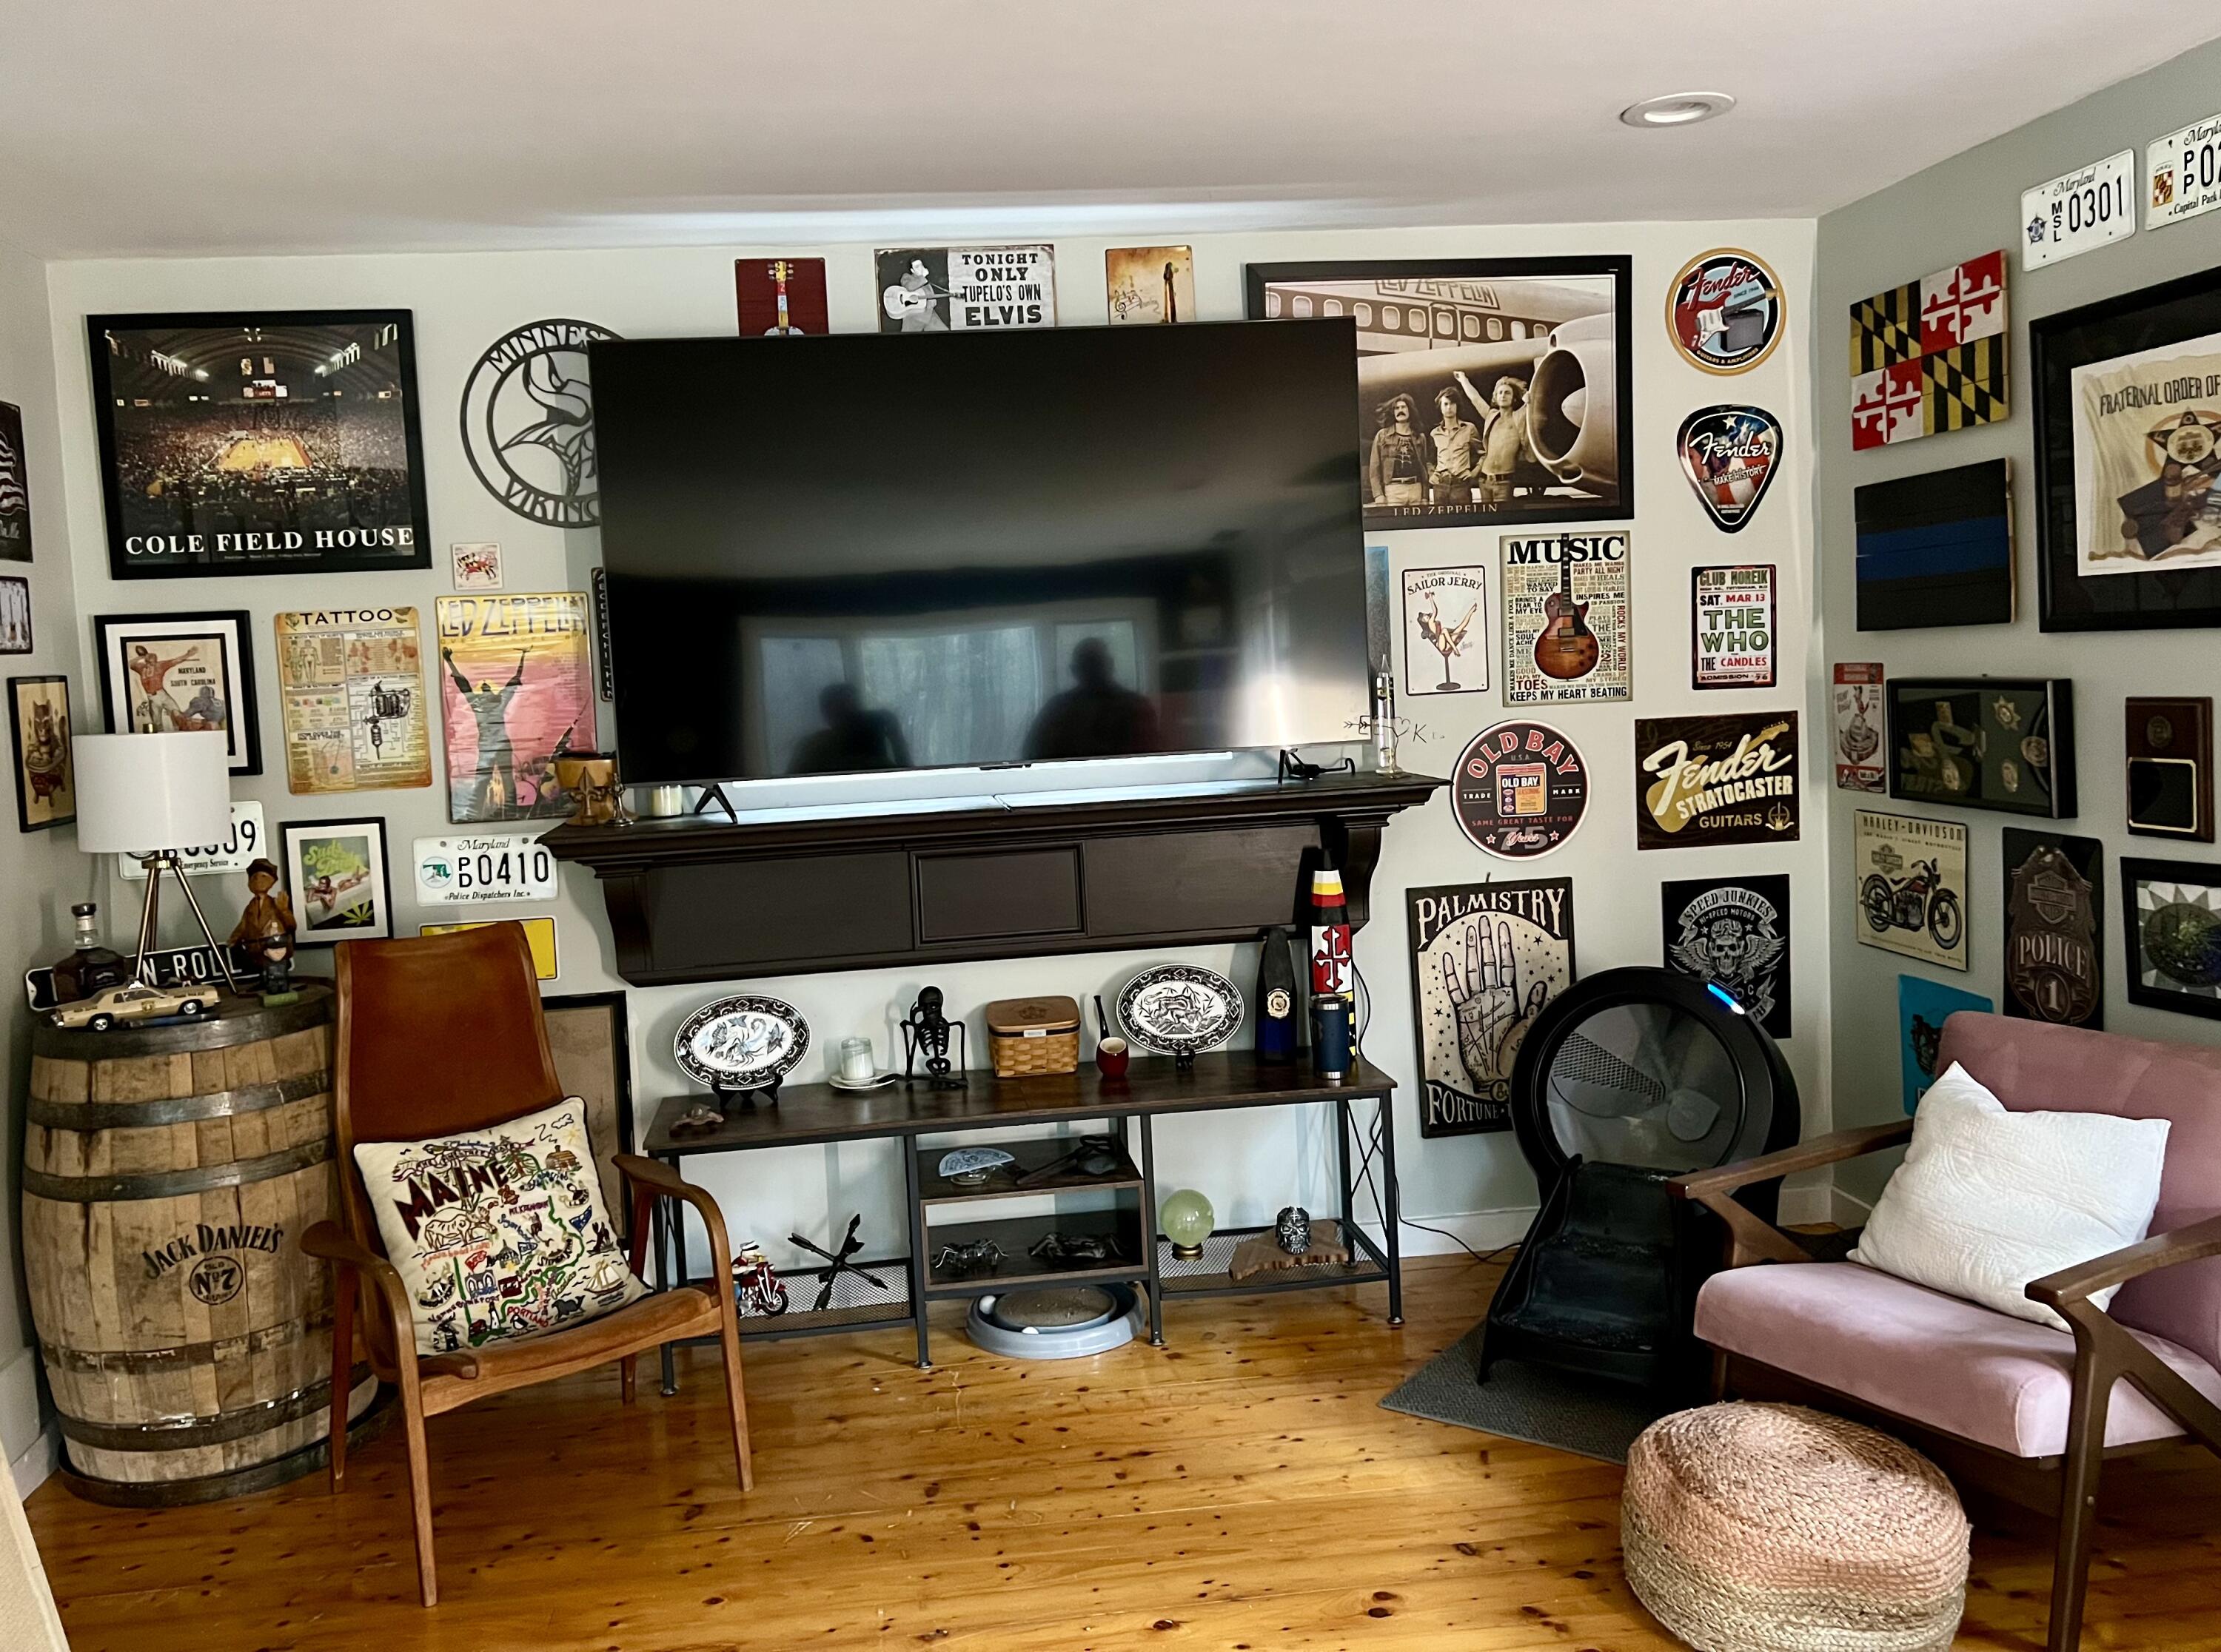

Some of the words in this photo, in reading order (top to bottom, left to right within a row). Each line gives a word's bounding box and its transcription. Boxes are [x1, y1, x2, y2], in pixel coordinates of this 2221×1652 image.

[2054, 167, 2097, 196] Maryland
[2068, 175, 2123, 233] 0301
[2174, 197, 2199, 215] Capital
[2202, 191, 2217, 206] Park
[962, 253, 1038, 265] TONIGHT
[975, 267, 1028, 281] ONLY
[962, 284, 1013, 302] TUPELO'S
[1019, 283, 1042, 300] OWN
[1681, 261, 1761, 311] Fender
[965, 304, 1042, 326] ELVIS
[1696, 350, 1720, 364] GUITARS
[2100, 384, 2162, 417] FRATERNAL
[2164, 376, 2202, 404] ORDER
[2206, 375, 2220, 397] OF
[1689, 431, 1771, 465] Fender
[1714, 475, 1733, 486] MAKE
[1734, 467, 1763, 480] HISTORY
[125, 534, 204, 555] COLE
[215, 531, 303, 551] FIELD
[315, 528, 414, 549] HOUSE
[1507, 537, 1624, 564] MUSIC
[1407, 577, 1445, 595] SAILOR
[1447, 577, 1482, 590] JERRY
[1699, 571, 1726, 586] CLUB
[1700, 594, 1723, 606] SAT.
[1726, 594, 1752, 602] MAR
[300, 609, 392, 625] TATTOO
[438, 599, 477, 637] LED
[1617, 605, 1626, 631] ROCKS
[1704, 608, 1765, 630] THE
[1618, 632, 1626, 643] MY
[1701, 631, 1769, 653] WHO
[1510, 659, 1515, 668] ME
[1618, 646, 1627, 671] WORLD
[1701, 657, 1716, 671] THE
[1721, 657, 1767, 666] CANDLES
[1510, 691, 1537, 702] KEEPS
[1541, 690, 1554, 700] MY
[1558, 688, 1587, 699] HEART
[1591, 686, 1627, 698] BEATING
[1516, 679, 1548, 690] TOES
[1467, 731, 1518, 779] OLD
[1525, 729, 1580, 776] BAY
[1692, 741, 1712, 751] Since
[1511, 753, 1532, 762] U.S.A.
[1502, 778, 1519, 788] OLD
[1521, 776, 1538, 787] BAY
[1643, 733, 1793, 816] Fender
[1676, 775, 1793, 819] STRATOCASTER
[1498, 817, 1524, 825] GREAT
[1699, 813, 1763, 828] GUITARS
[1863, 816, 1963, 841] HARLEY-DAVIDSON
[458, 839, 511, 853] Maryland
[1497, 825, 1549, 851] 75
[1507, 831, 1540, 847] Years
[210, 859, 229, 867] Service
[478, 851, 549, 886] 0410
[449, 893, 470, 901] Police
[472, 890, 511, 901] Dispatchers
[1684, 893, 1718, 922] SPEED
[1723, 890, 1772, 918] JUNKIES
[1416, 887, 1566, 949] PALMISTRY
[1698, 908, 1728, 924] HI-SPEED
[1730, 908, 1755, 921] MOTORS
[2020, 933, 2087, 980] POLICE
[2046, 978, 2062, 1013] 1
[1426, 1083, 1499, 1125] FORTUNE
[392, 1161, 509, 1243] MAINE
[141, 1235, 198, 1280] JACK
[196, 1223, 284, 1254] DANIEL'S
[507, 1306, 549, 1328] PORTLAND
